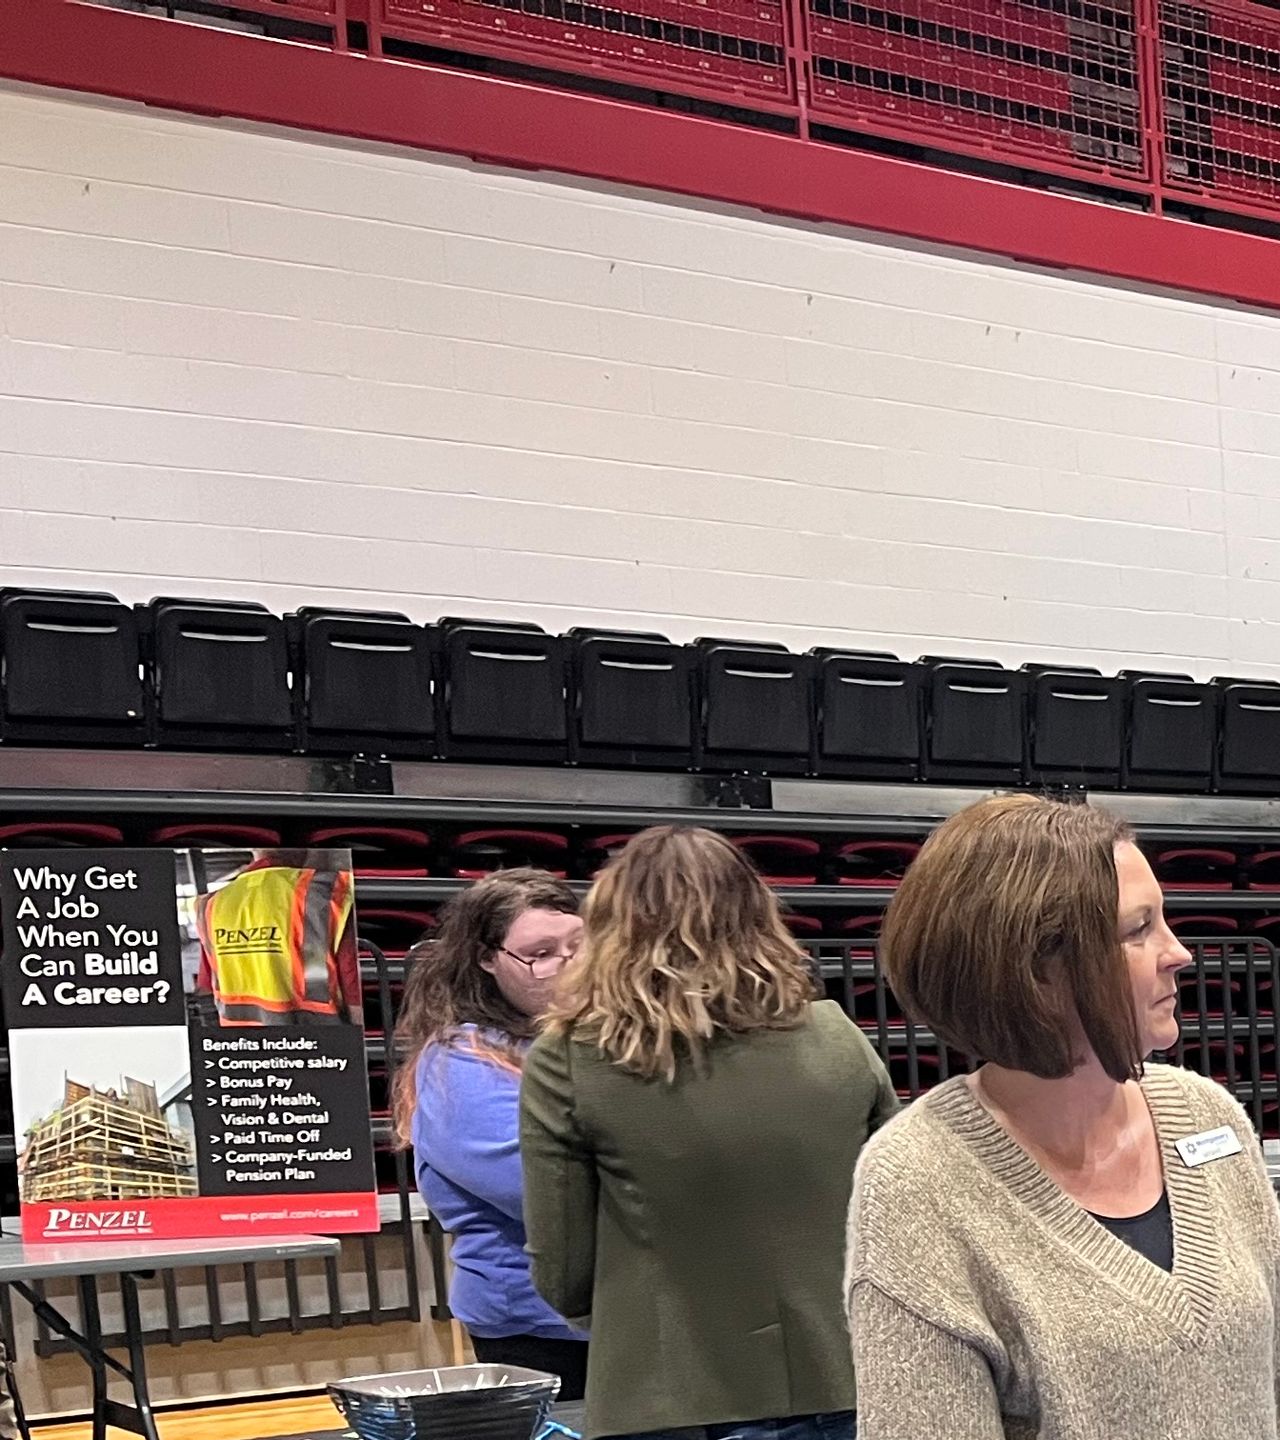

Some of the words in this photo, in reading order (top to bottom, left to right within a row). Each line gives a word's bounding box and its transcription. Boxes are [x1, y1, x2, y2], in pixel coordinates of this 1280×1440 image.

[13, 866, 77, 897] Why
[84, 866, 138, 890] Get
[16, 896, 40, 920] A
[46, 894, 100, 919] Job
[16, 924, 100, 948] When
[106, 924, 159, 947] You
[214, 926, 282, 945] PENZEL
[20, 953, 76, 977] Can
[84, 951, 159, 976] Build
[21, 983, 48, 1006] A
[54, 980, 171, 1006] Career?
[202, 1037, 260, 1052] Benefits
[262, 1037, 318, 1051] Include:
[218, 1056, 305, 1073] Competitive
[307, 1055, 348, 1071] salary
[219, 1076, 265, 1089] Bonus
[266, 1075, 293, 1090] Pay
[221, 1094, 268, 1110] Family
[270, 1093, 321, 1107] Health,
[220, 1113, 265, 1126] Vision
[267, 1112, 280, 1125] &
[282, 1111, 329, 1125] Dental
[223, 1131, 256, 1145] Paid
[258, 1130, 294, 1143] Time
[296, 1129, 321, 1142] Off
[225, 1147, 352, 1166] Company-Funded
[226, 1168, 282, 1182] Pension
[284, 1167, 316, 1181] Plan
[46, 1208, 153, 1230] PENZEL
